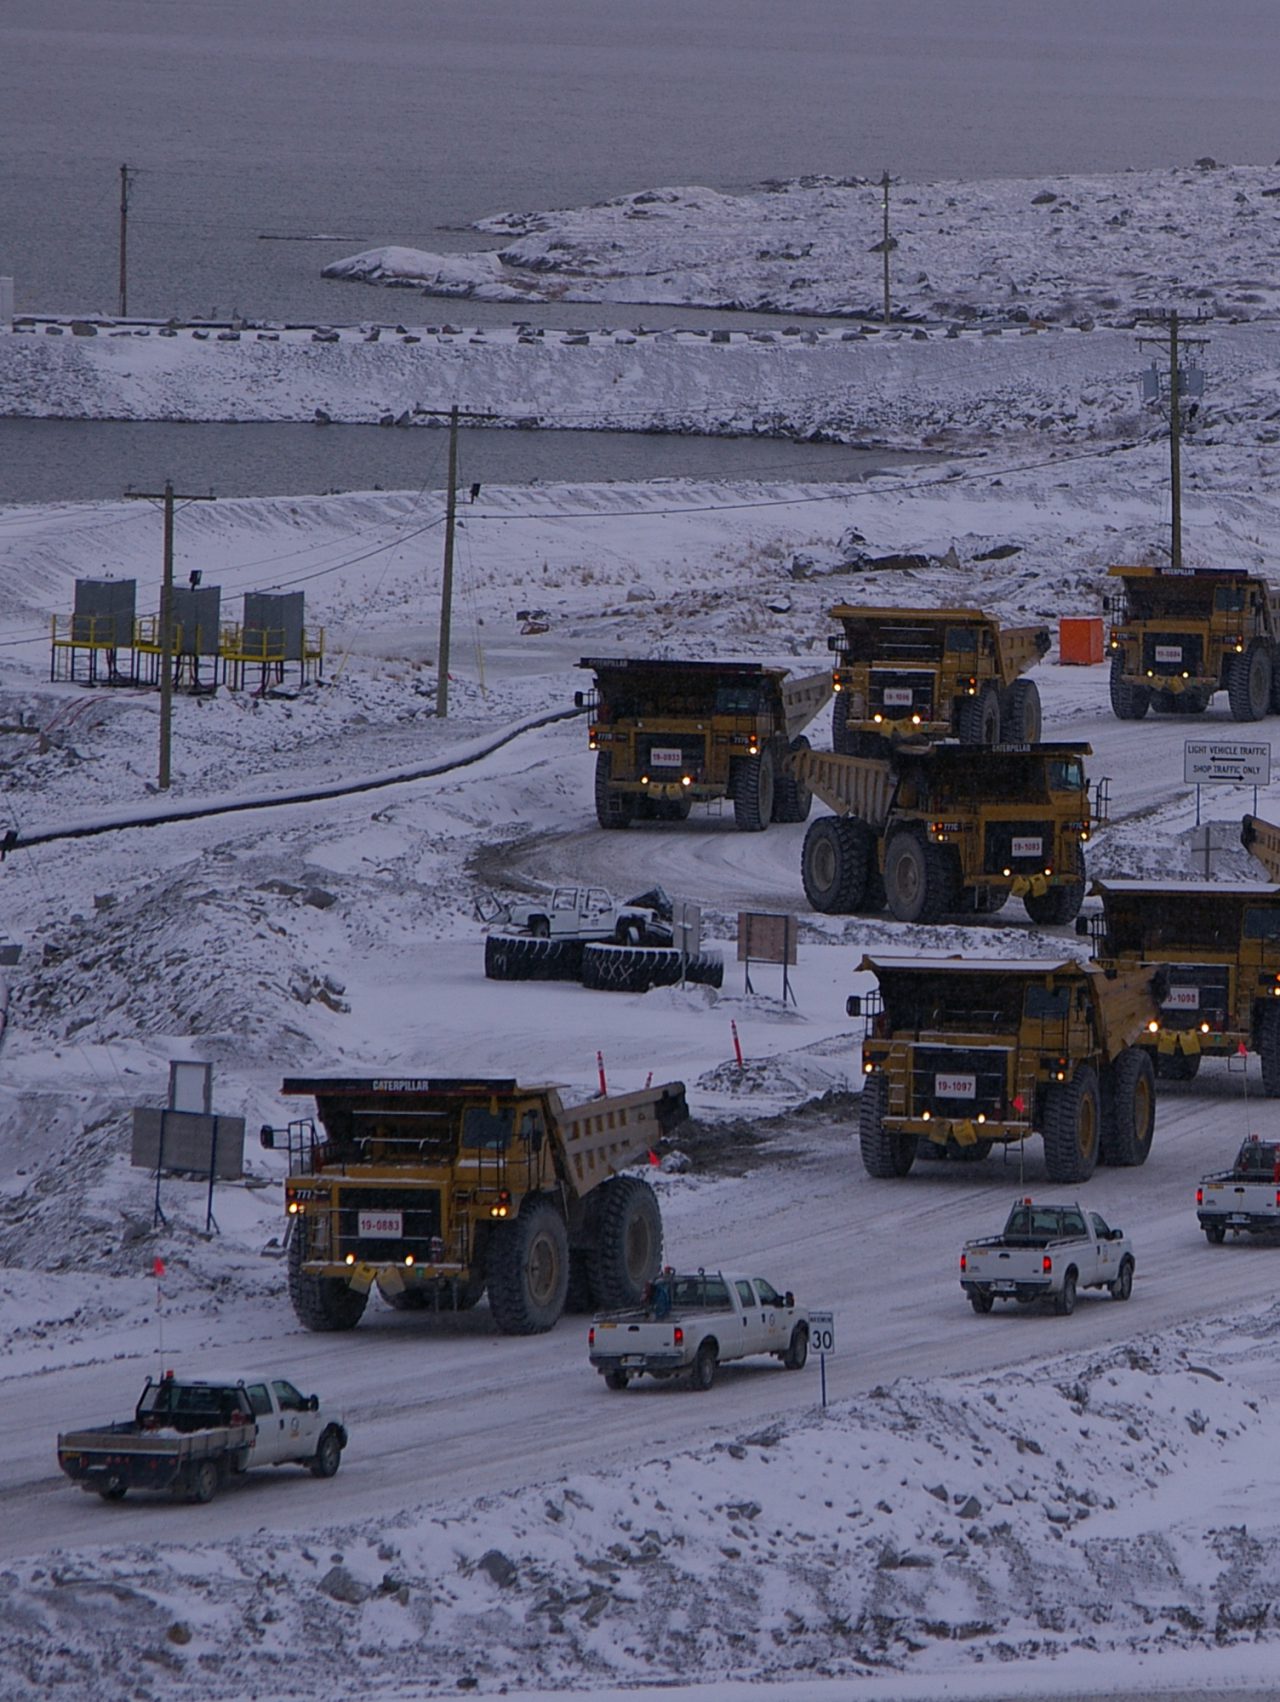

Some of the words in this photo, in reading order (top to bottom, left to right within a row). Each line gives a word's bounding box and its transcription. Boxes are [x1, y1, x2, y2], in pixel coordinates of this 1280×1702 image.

[588, 658, 628, 668] CATERPILLAR
[991, 743, 1031, 752] CATERPILLAR
[1188, 745, 1207, 754] LIGHT
[1209, 746, 1237, 755] VEHICLE
[1240, 747, 1267, 756] TRAFFIC
[1193, 765, 1212, 773] SHOP
[1213, 765, 1240, 774] TRAFFIC
[1243, 766, 1260, 774] ONLY
[372, 1080, 429, 1091] CATERPILLAR
[937, 1081, 973, 1092] 19-1097
[361, 1220, 400, 1231] 19-0883
[812, 1330, 832, 1349] 30
